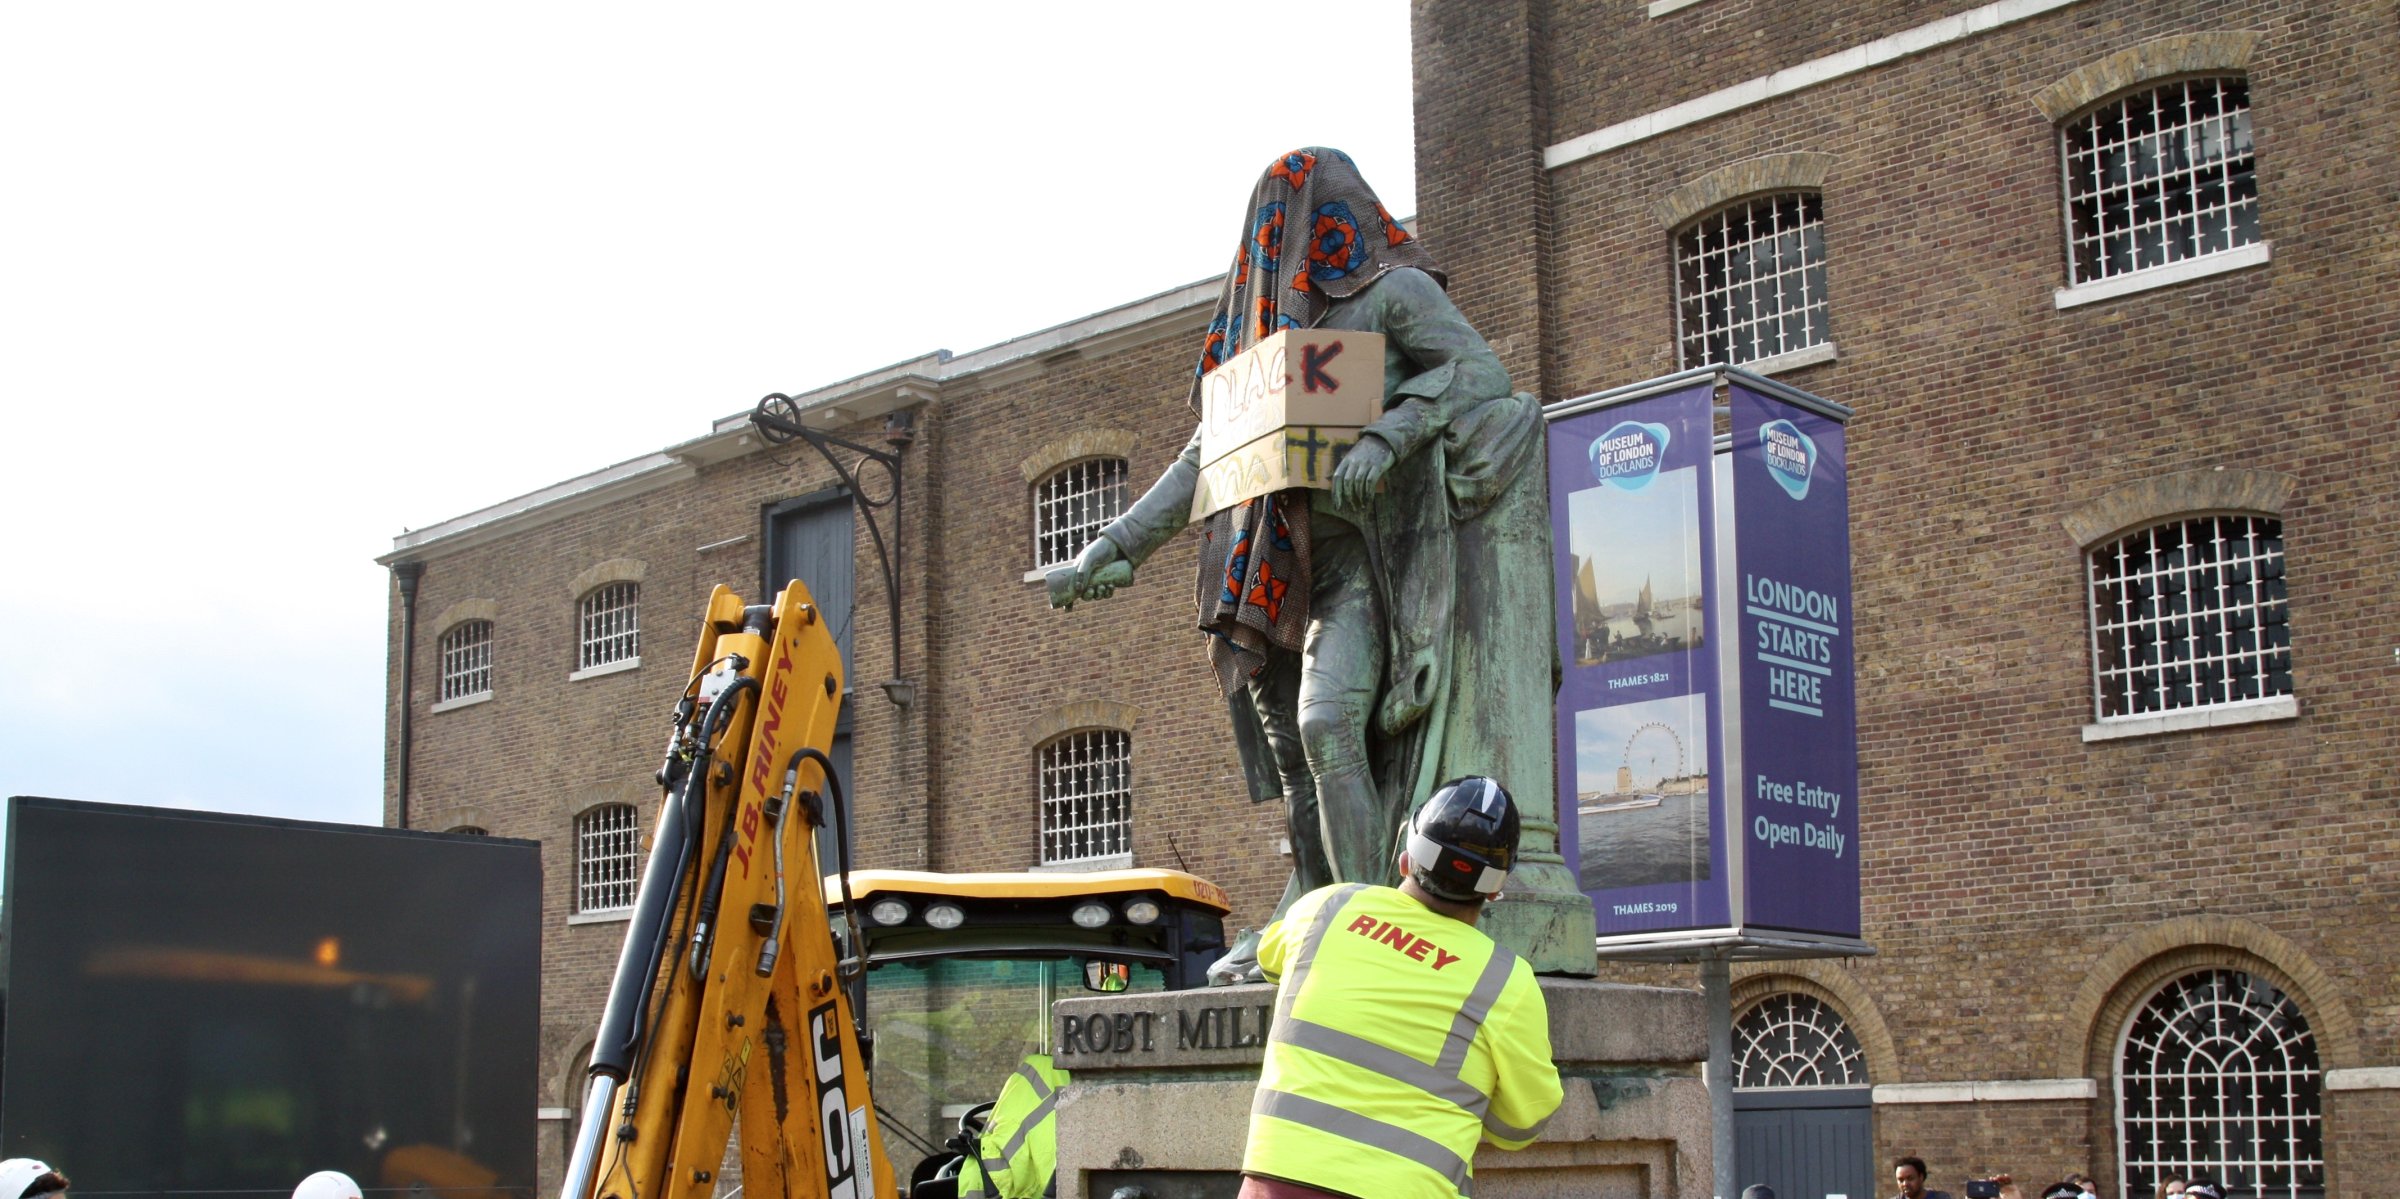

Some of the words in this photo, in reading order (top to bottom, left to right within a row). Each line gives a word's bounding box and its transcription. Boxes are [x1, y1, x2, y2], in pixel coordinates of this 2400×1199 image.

[1600, 432, 1643, 454] MUSEUM
[1600, 453, 1612, 466] OF
[1614, 443, 1653, 463] LONDON
[1766, 428, 1798, 449] MUSEUM
[1767, 440, 1776, 455] OF
[1777, 444, 1805, 464] LONDON
[1600, 456, 1653, 478] DOCKLANDS
[1767, 454, 1805, 476] DOCKLANDS
[1747, 573, 1837, 623] LONDON
[1758, 620, 1830, 663] STARTS
[1608, 675, 1648, 690] THAMES
[1649, 672, 1669, 684] 1821
[1770, 667, 1822, 705] HERE
[736, 801, 762, 881] J.B.
[752, 636, 793, 799] RINEY
[1757, 774, 1793, 804] Free
[1797, 782, 1841, 818] Entry
[1754, 815, 1800, 848] Open
[1804, 823, 1845, 859] Daily
[1613, 903, 1654, 916] THAMES
[1655, 902, 1678, 914] 2019
[1346, 914, 1461, 971] RINEY
[1060, 1010, 1154, 1055] ROBT
[813, 1013, 859, 1199] JC
